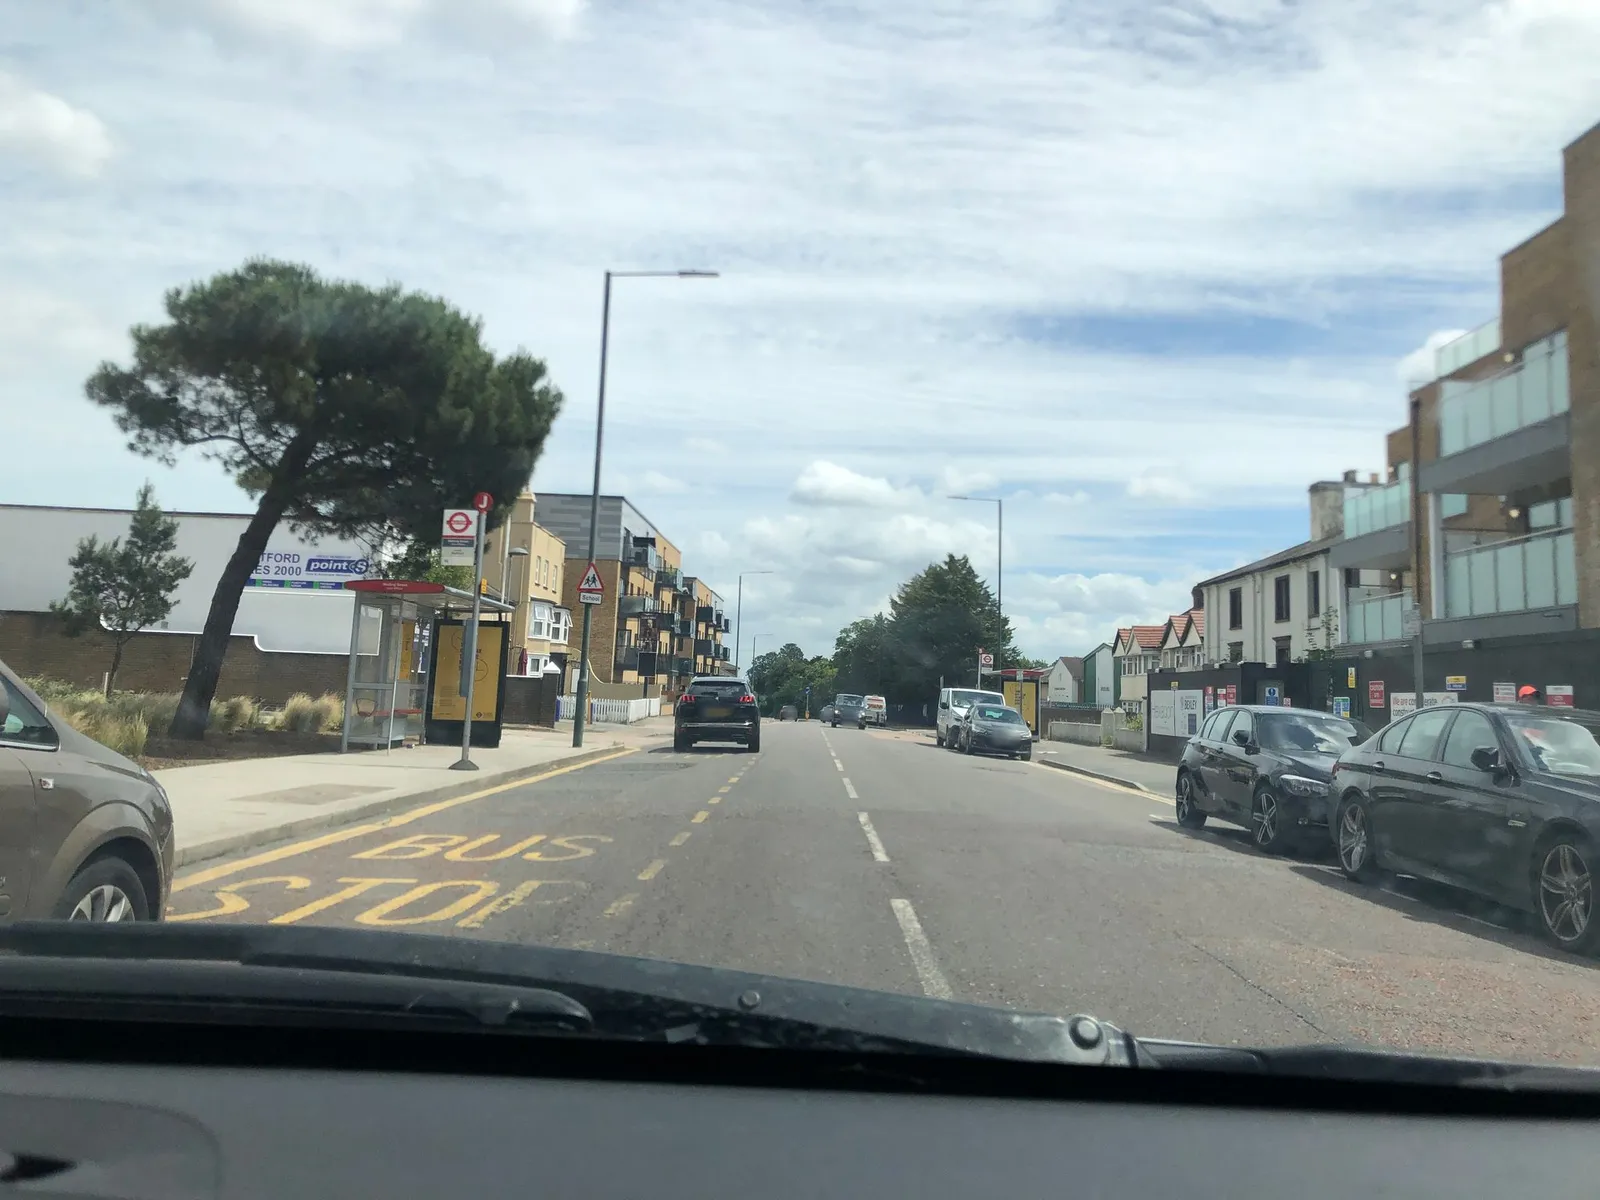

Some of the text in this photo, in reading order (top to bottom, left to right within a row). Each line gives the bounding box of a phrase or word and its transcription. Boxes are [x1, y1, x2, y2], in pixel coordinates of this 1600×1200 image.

[478, 495, 488, 509] J
[260, 552, 300, 564] TFORD
[274, 566, 302, 576] 2000
[309, 559, 348, 571] point
[582, 594, 600, 602] School
[349, 833, 614, 863] BUS
[165, 874, 587, 929] STOP
